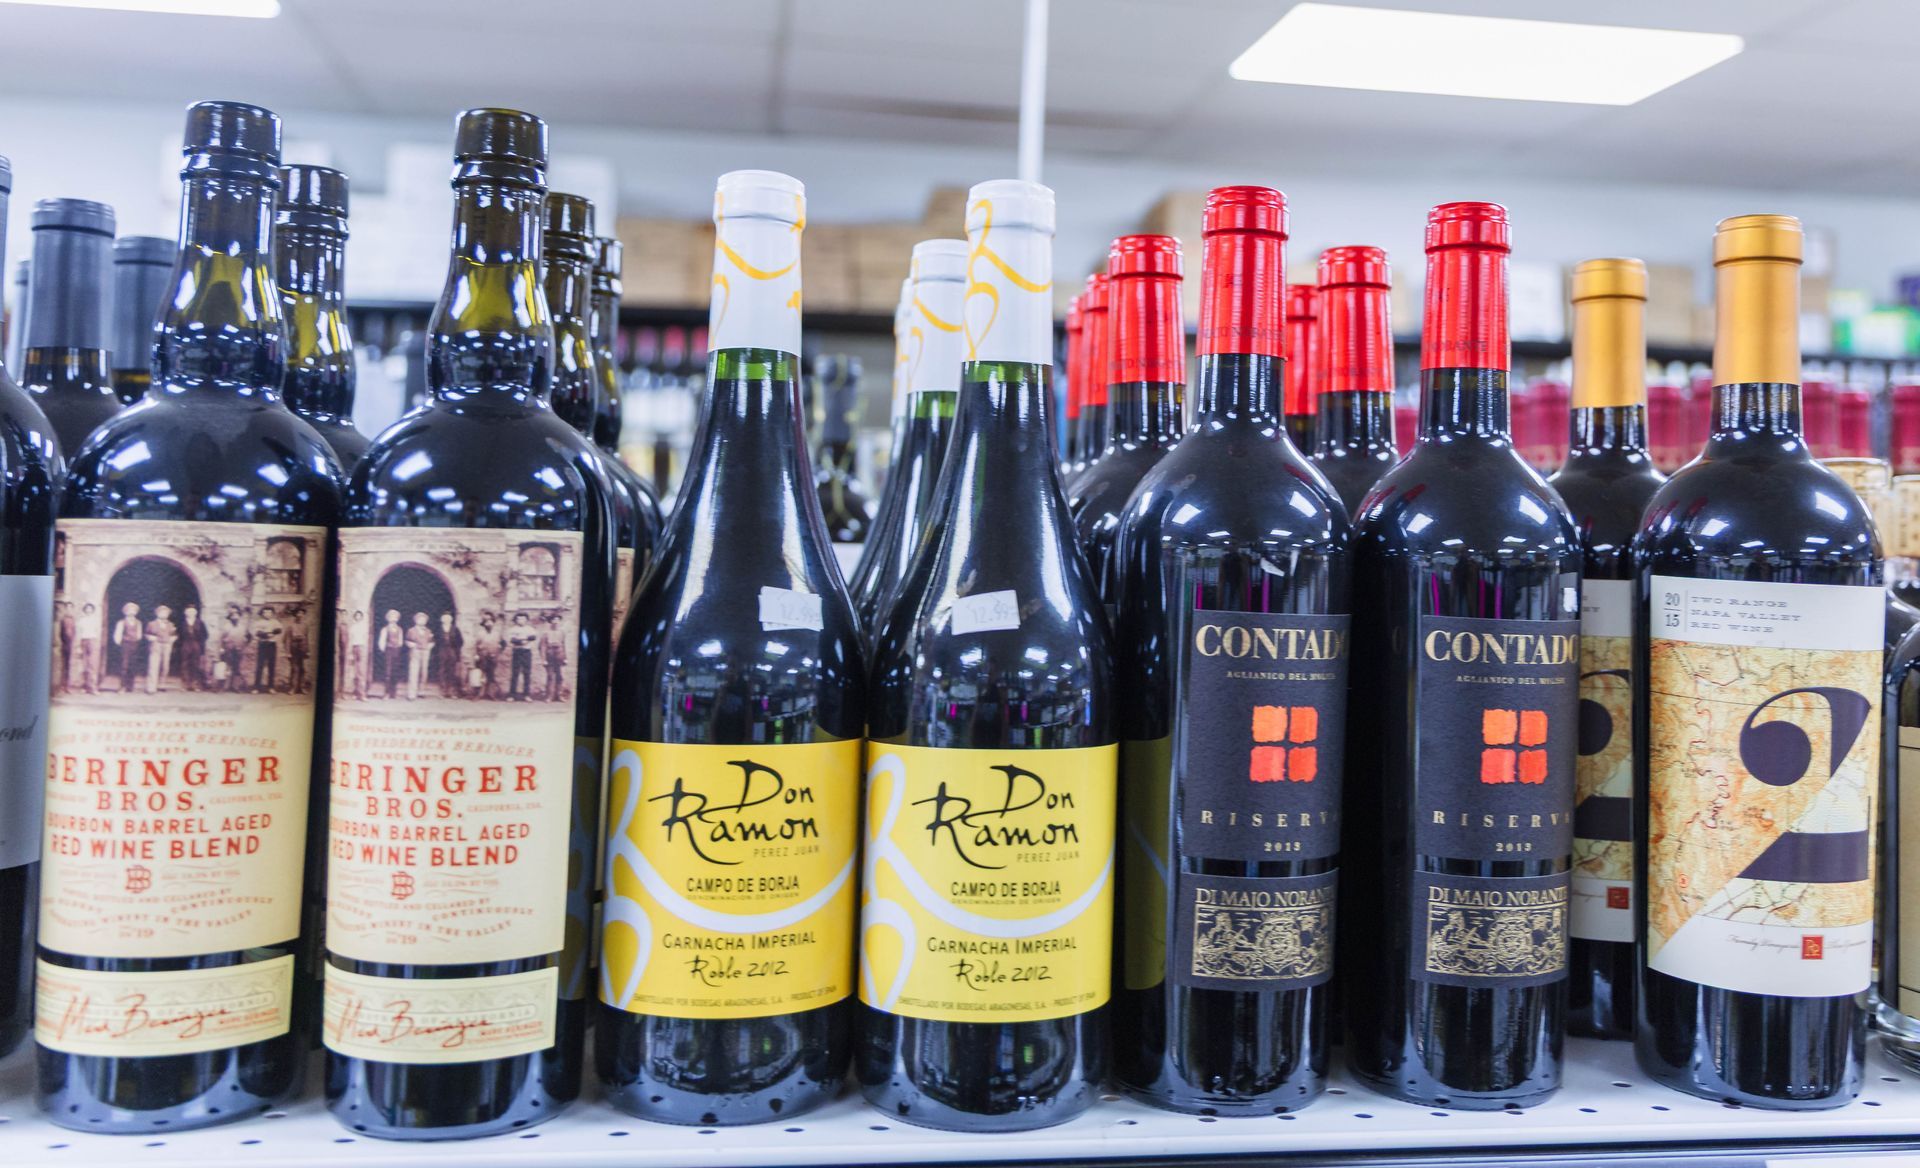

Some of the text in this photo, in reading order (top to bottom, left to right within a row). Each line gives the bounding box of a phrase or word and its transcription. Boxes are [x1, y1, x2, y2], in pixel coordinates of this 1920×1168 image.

[1664, 592, 1680, 607] 20
[1690, 596, 1788, 608] TWO RANGE
[1665, 613, 1680, 627] 15
[1690, 608, 1802, 622] NAPA VALLEY
[1689, 621, 1774, 633] RED WINE
[1288, 671, 1308, 681] DEL
[1517, 676, 1537, 685] DEL
[700, 759, 814, 820] Don
[965, 764, 1075, 823] Don
[1739, 686, 1872, 883] 2
[97, 789, 205, 812] BROS.
[366, 796, 463, 819] BROS.
[124, 817, 210, 835] BARREL
[221, 813, 273, 832] AGED
[648, 777, 819, 865] Ramon
[912, 781, 1079, 870] Ramon
[1200, 810, 1337, 828] RISERV
[389, 824, 468, 842] BARREL
[479, 823, 531, 841] AGED
[51, 834, 261, 860] RED WINE BLEND
[360, 845, 418, 867] WINE
[430, 844, 519, 867] BLEND
[753, 844, 820, 858] PEREZ JUAN
[1264, 841, 1302, 852] 2013
[1495, 842, 1533, 852] 2013
[1017, 850, 1080, 863] PEREZ JUAN
[686, 875, 800, 893] CAMPO DE BORJA
[950, 880, 1062, 897] CAMPO DE BORJA
[1195, 887, 1217, 905] DI
[1428, 885, 1449, 903] DI
[662, 930, 817, 951] GARNACHA IMPERIAL
[927, 936, 1078, 955] GARNACHA IMPERIAL
[684, 954, 791, 987] Roble 2012
[949, 958, 1053, 992] Roble 2012
